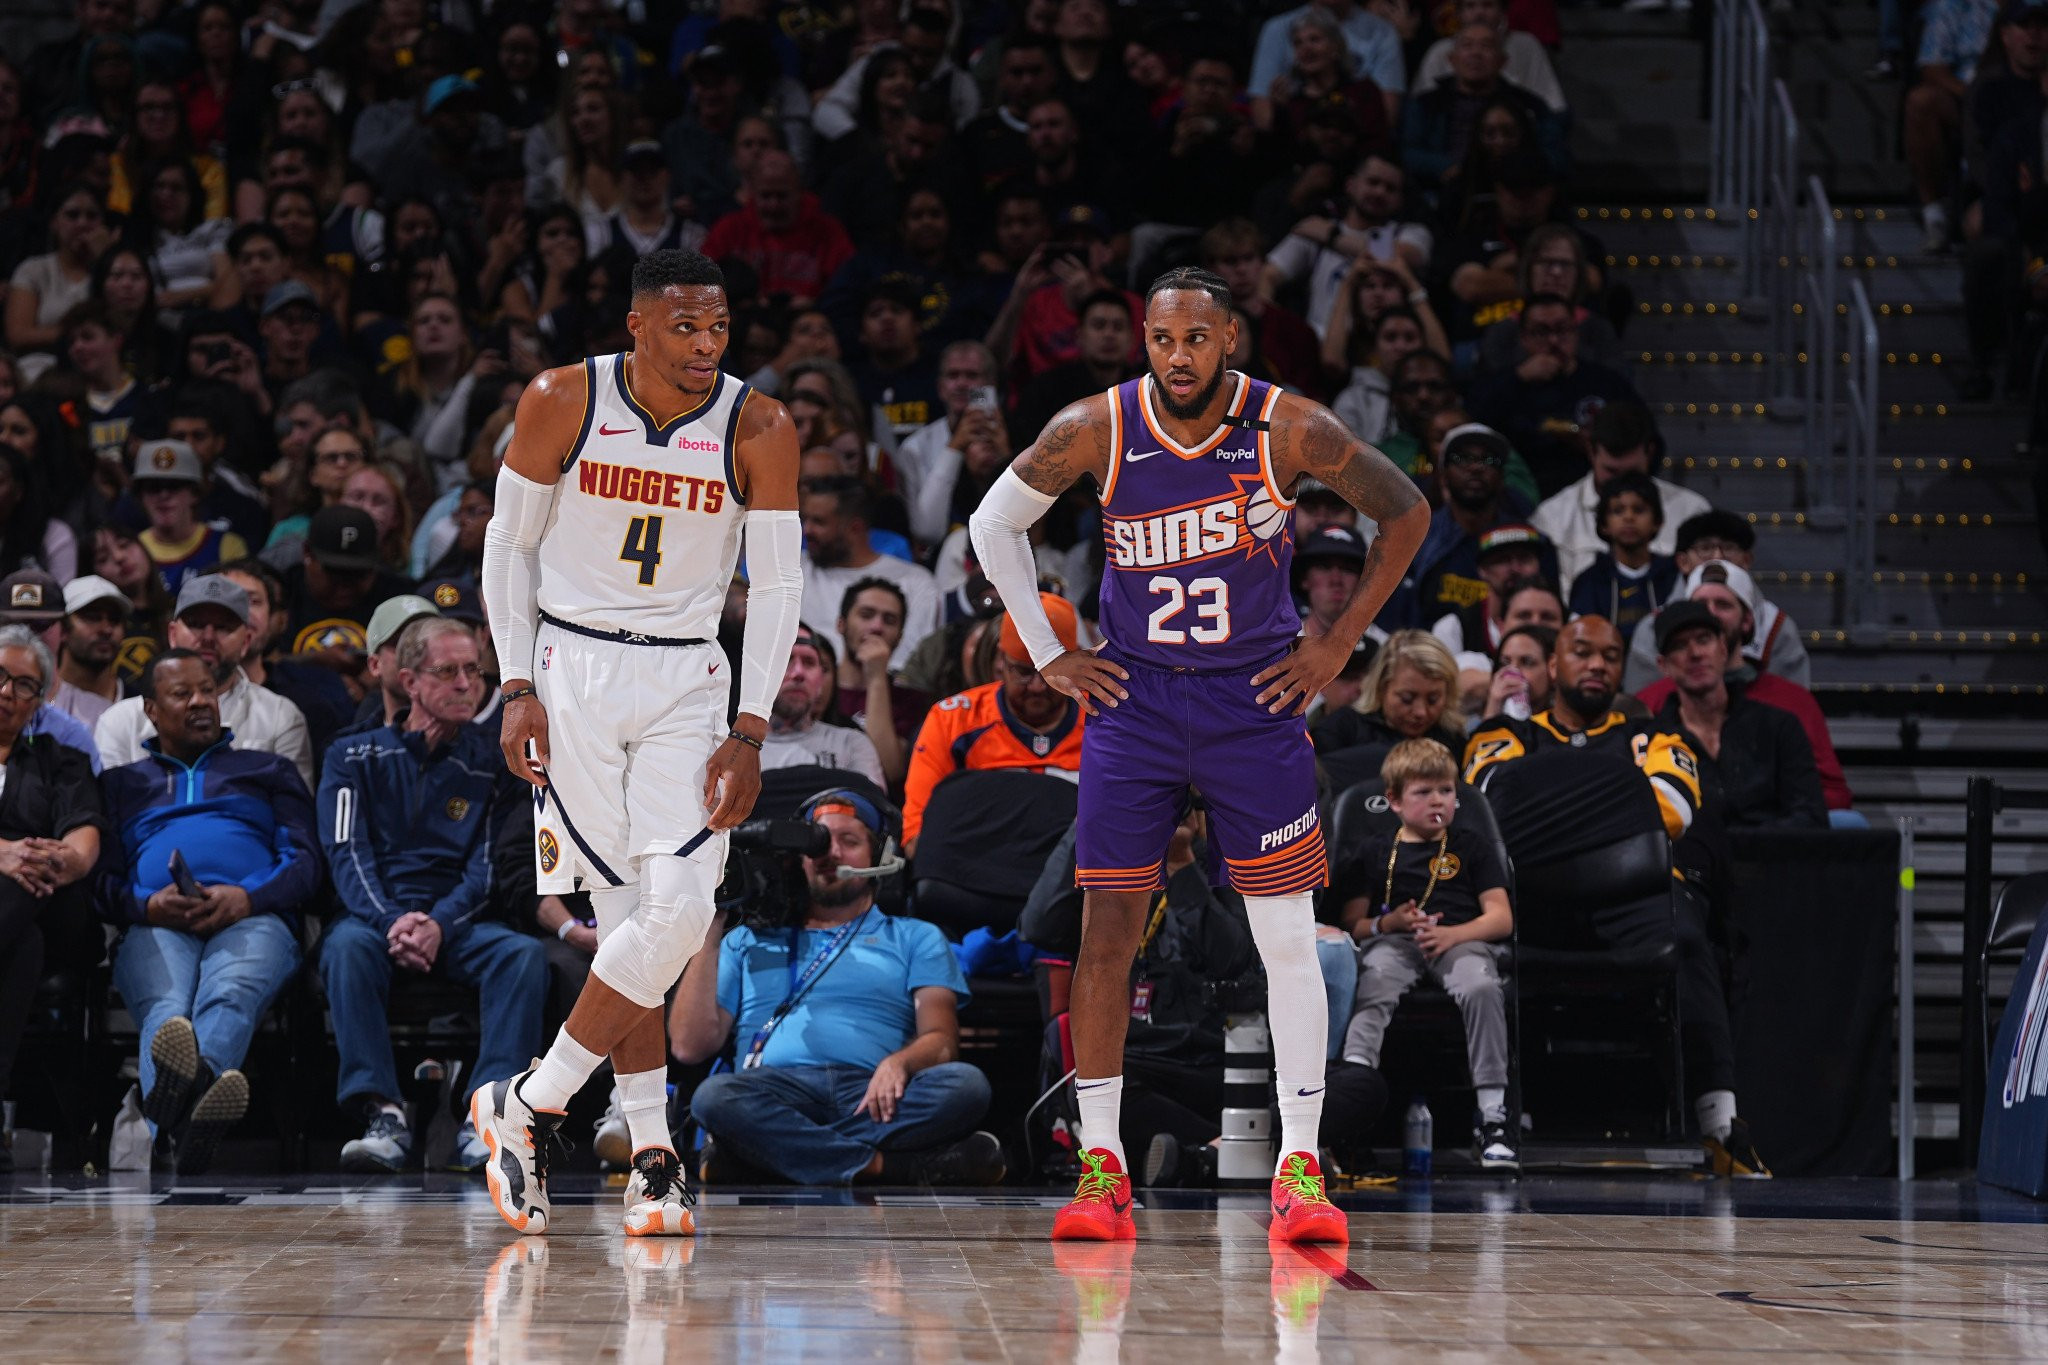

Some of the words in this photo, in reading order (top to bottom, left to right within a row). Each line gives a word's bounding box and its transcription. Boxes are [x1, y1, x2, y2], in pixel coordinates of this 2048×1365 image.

[678, 437, 719, 453] ibotta
[1216, 448, 1255, 462] PayPal
[578, 459, 726, 514] NUGGETS
[340, 526, 359, 550] P
[618, 513, 664, 587] 4
[1114, 500, 1239, 567] SUNS
[1147, 575, 1231, 644] 23
[1260, 802, 1318, 852] PHOENIX
